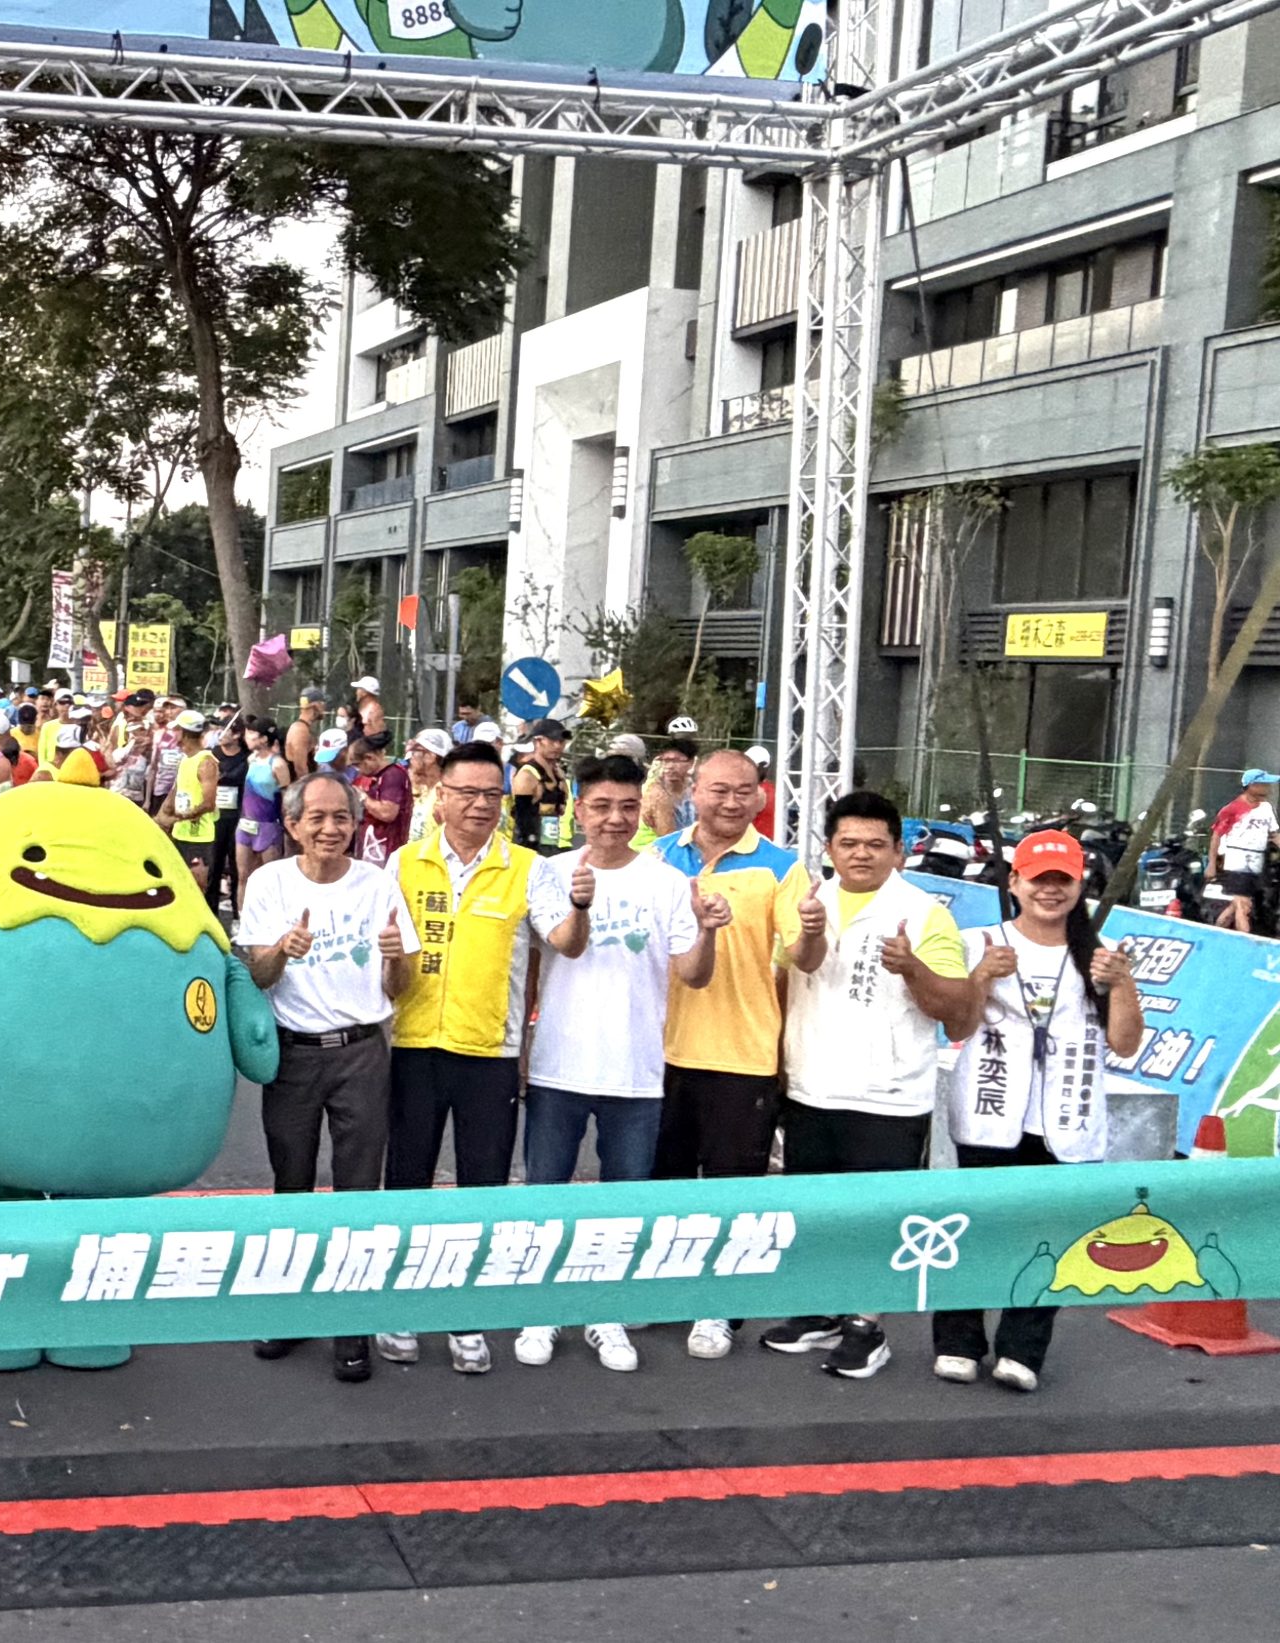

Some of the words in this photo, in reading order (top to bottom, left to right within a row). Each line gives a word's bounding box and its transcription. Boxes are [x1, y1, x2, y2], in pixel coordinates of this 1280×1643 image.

[974, 1027, 1008, 1117] 林奕辰
[60, 1210, 797, 1302] 埔里山城派對馬拉松
